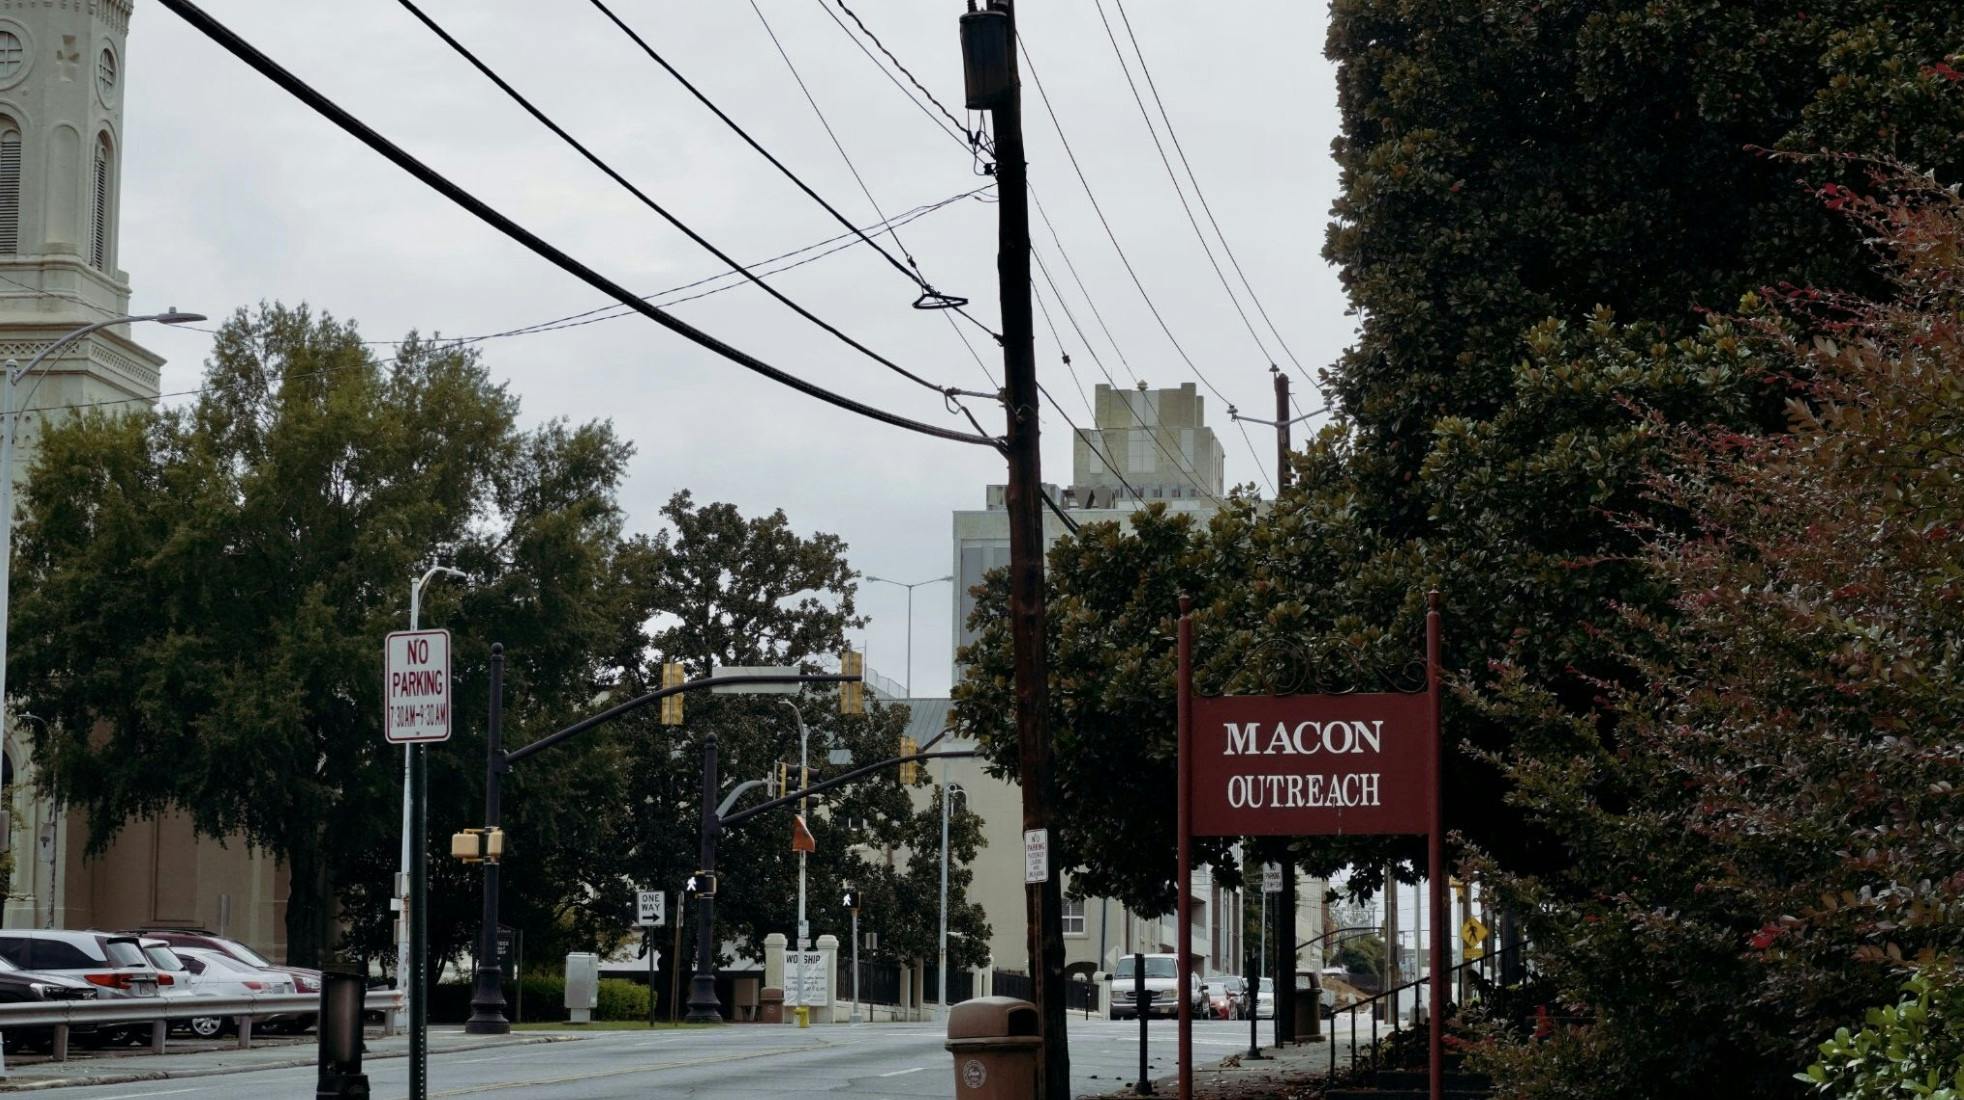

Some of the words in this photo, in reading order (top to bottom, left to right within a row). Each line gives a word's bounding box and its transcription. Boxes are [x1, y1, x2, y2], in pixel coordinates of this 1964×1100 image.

[407, 639, 429, 665] NO
[392, 670, 443, 698] PARKING
[1223, 720, 1384, 755] MACON
[1228, 773, 1381, 808] OUTREACH
[641, 903, 660, 912] WAY
[642, 893, 660, 903] ONE
[786, 954, 821, 965] WOSHIP
